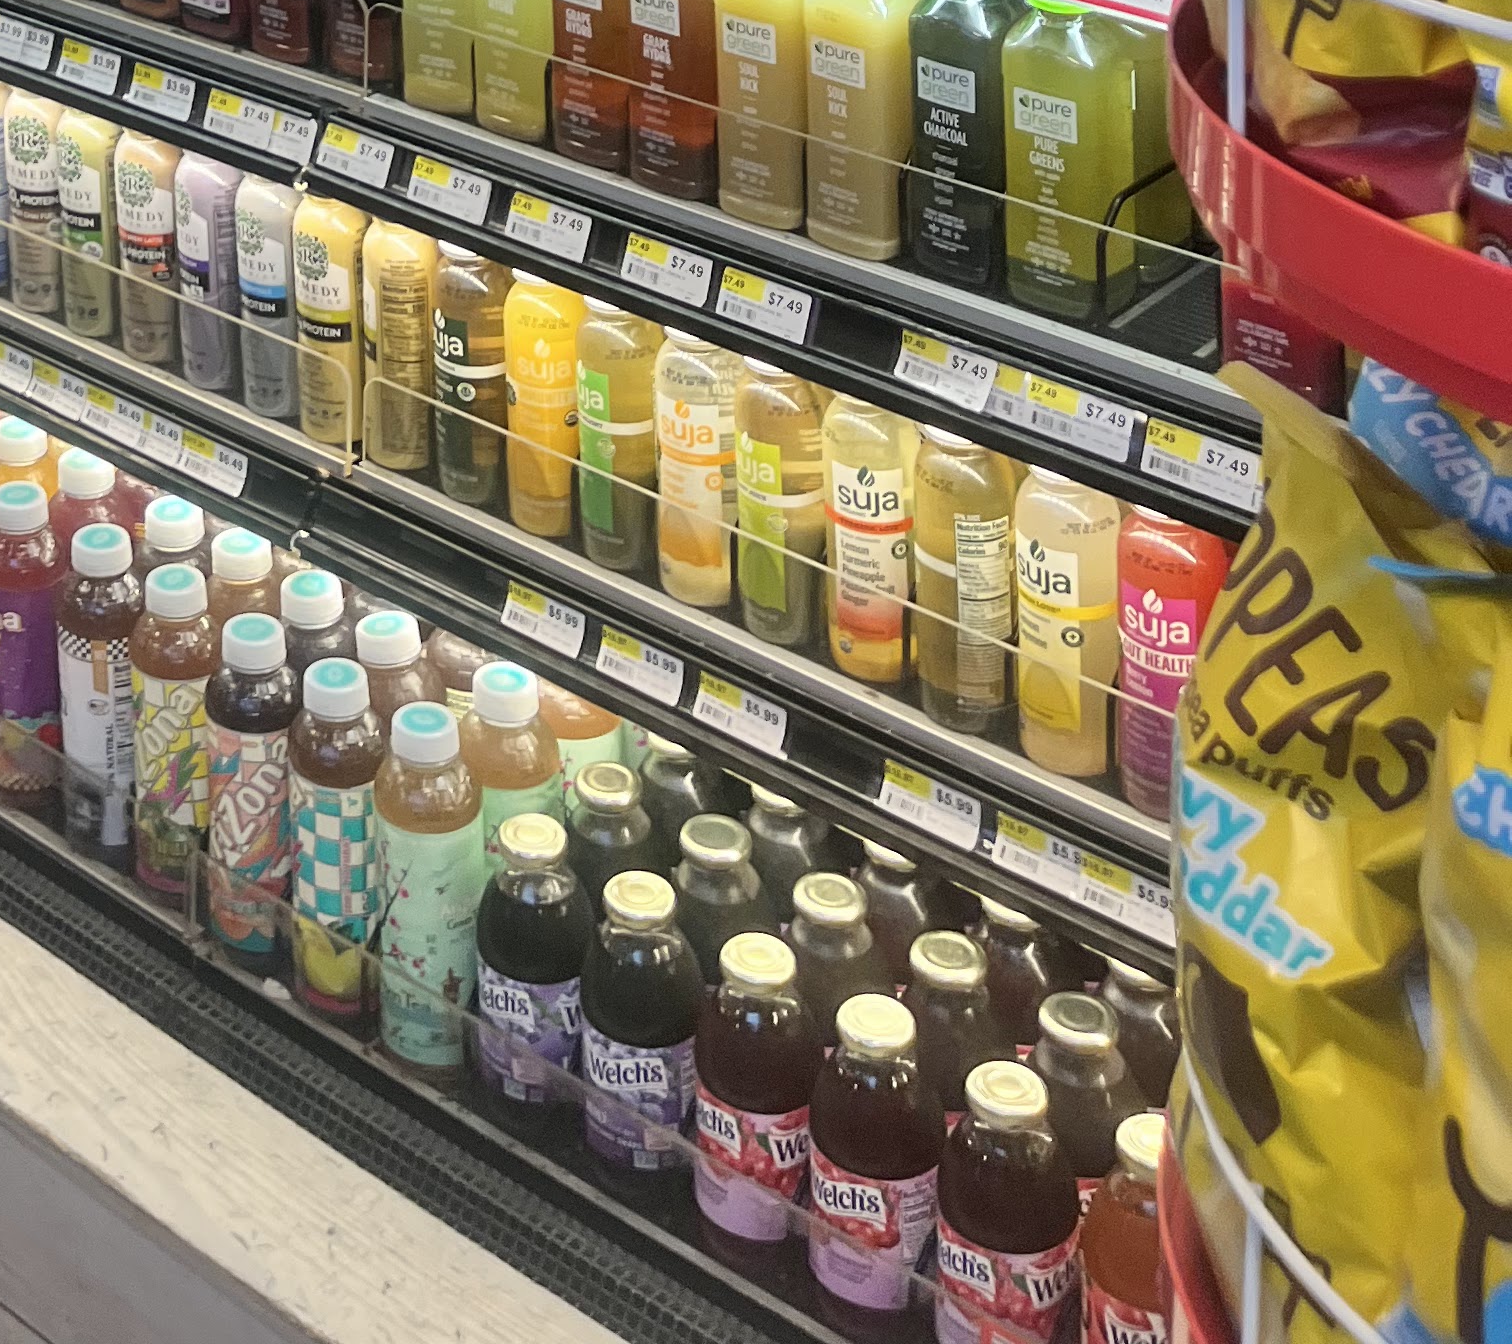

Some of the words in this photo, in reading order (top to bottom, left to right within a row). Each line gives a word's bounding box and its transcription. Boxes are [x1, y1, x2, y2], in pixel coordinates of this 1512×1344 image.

[735, 22, 772, 40] pure
[822, 47, 860, 64] pure
[933, 67, 969, 88] pure
[922, 81, 969, 109] green
[1029, 94, 1071, 118] pure
[931, 108, 959, 127] ACTIVE
[1020, 111, 1070, 139] green
[924, 123, 967, 146] CHARCOAL
[1034, 137, 1059, 154] PURE
[672, 260, 704, 278] $7.49
[769, 296, 802, 313] $7.49
[953, 358, 987, 378] $7.49
[1087, 405, 1126, 427] $7.49
[661, 412, 715, 446] suja
[1206, 448, 1250, 476] $7.49
[838, 485, 900, 516] suja
[1017, 562, 1072, 595] suja
[1125, 603, 1190, 647] suja
[937, 790, 973, 815] $5.99
[481, 987, 529, 1018] elch's
[589, 1059, 665, 1088] Welch's
[811, 1180, 883, 1216] Welch's
[939, 1241, 992, 1283] elch's
